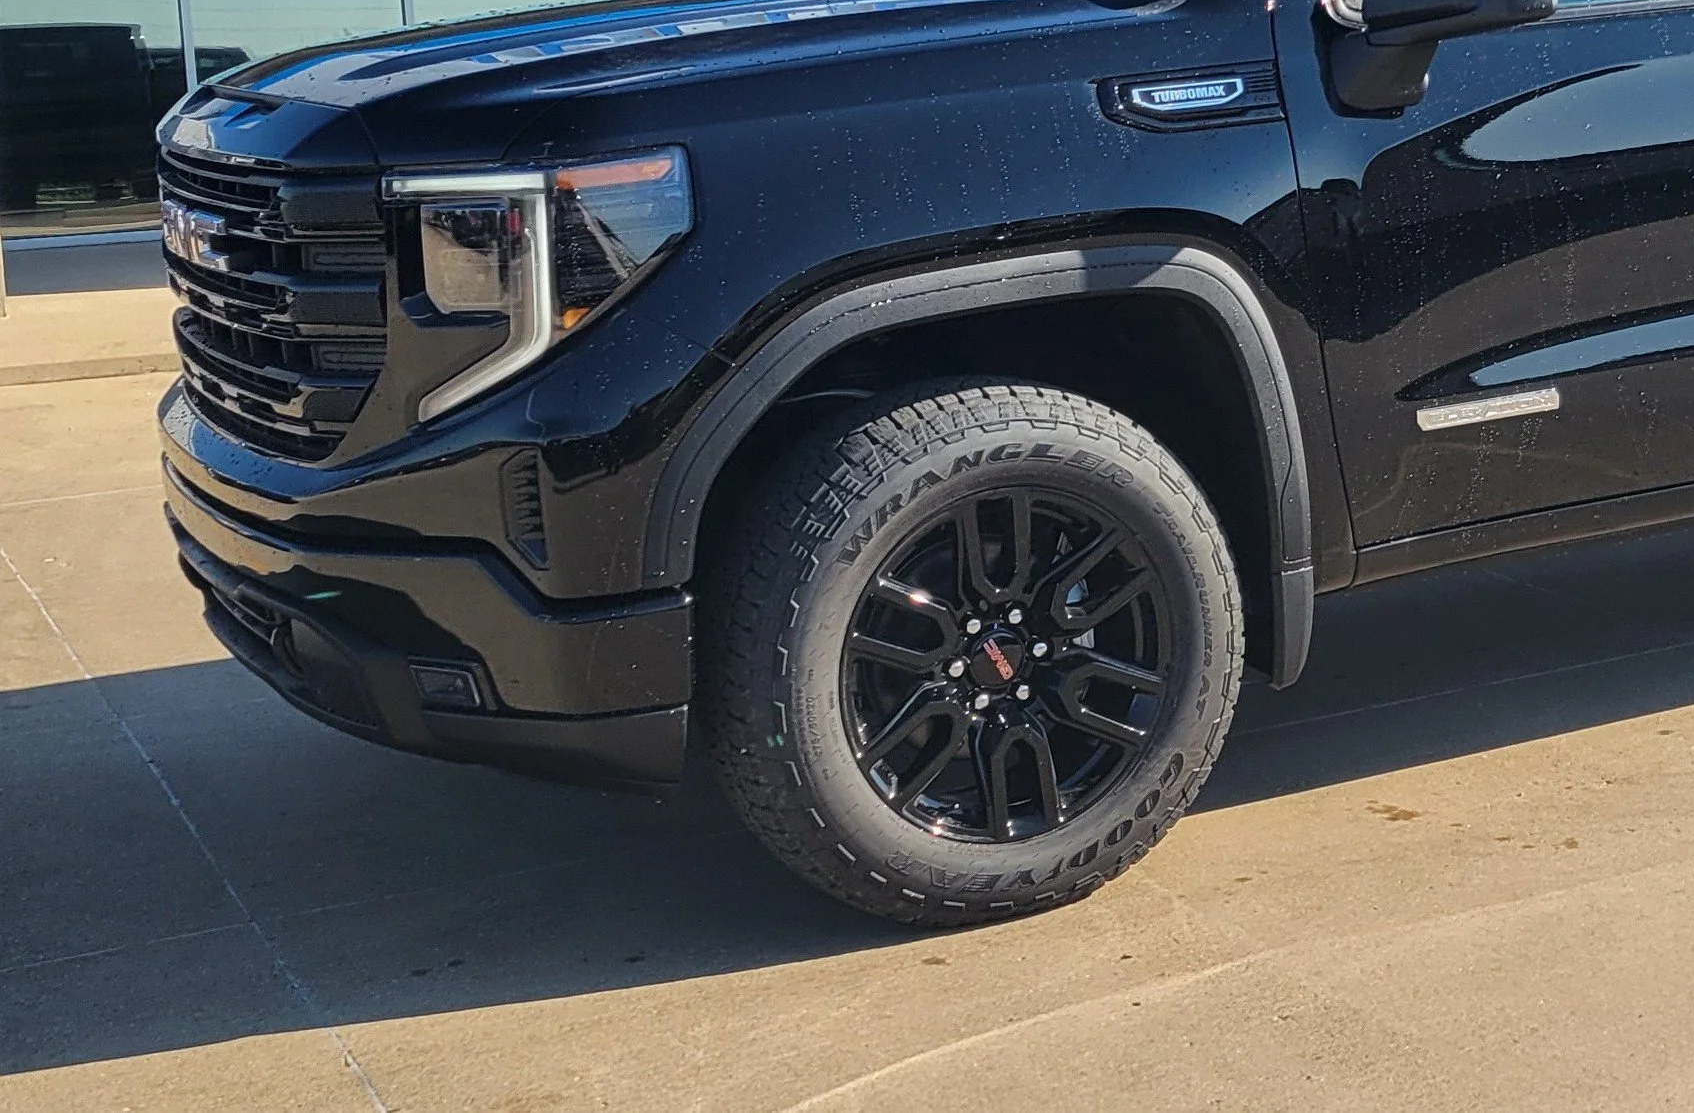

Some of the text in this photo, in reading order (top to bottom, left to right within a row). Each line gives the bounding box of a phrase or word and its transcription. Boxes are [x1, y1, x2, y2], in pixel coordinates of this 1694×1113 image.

[1151, 85, 1226, 103] TURBOMAX
[832, 443, 1134, 566] WRANGLER
[983, 638, 1014, 680] GMC
[885, 752, 1184, 892] GOODYEAR
